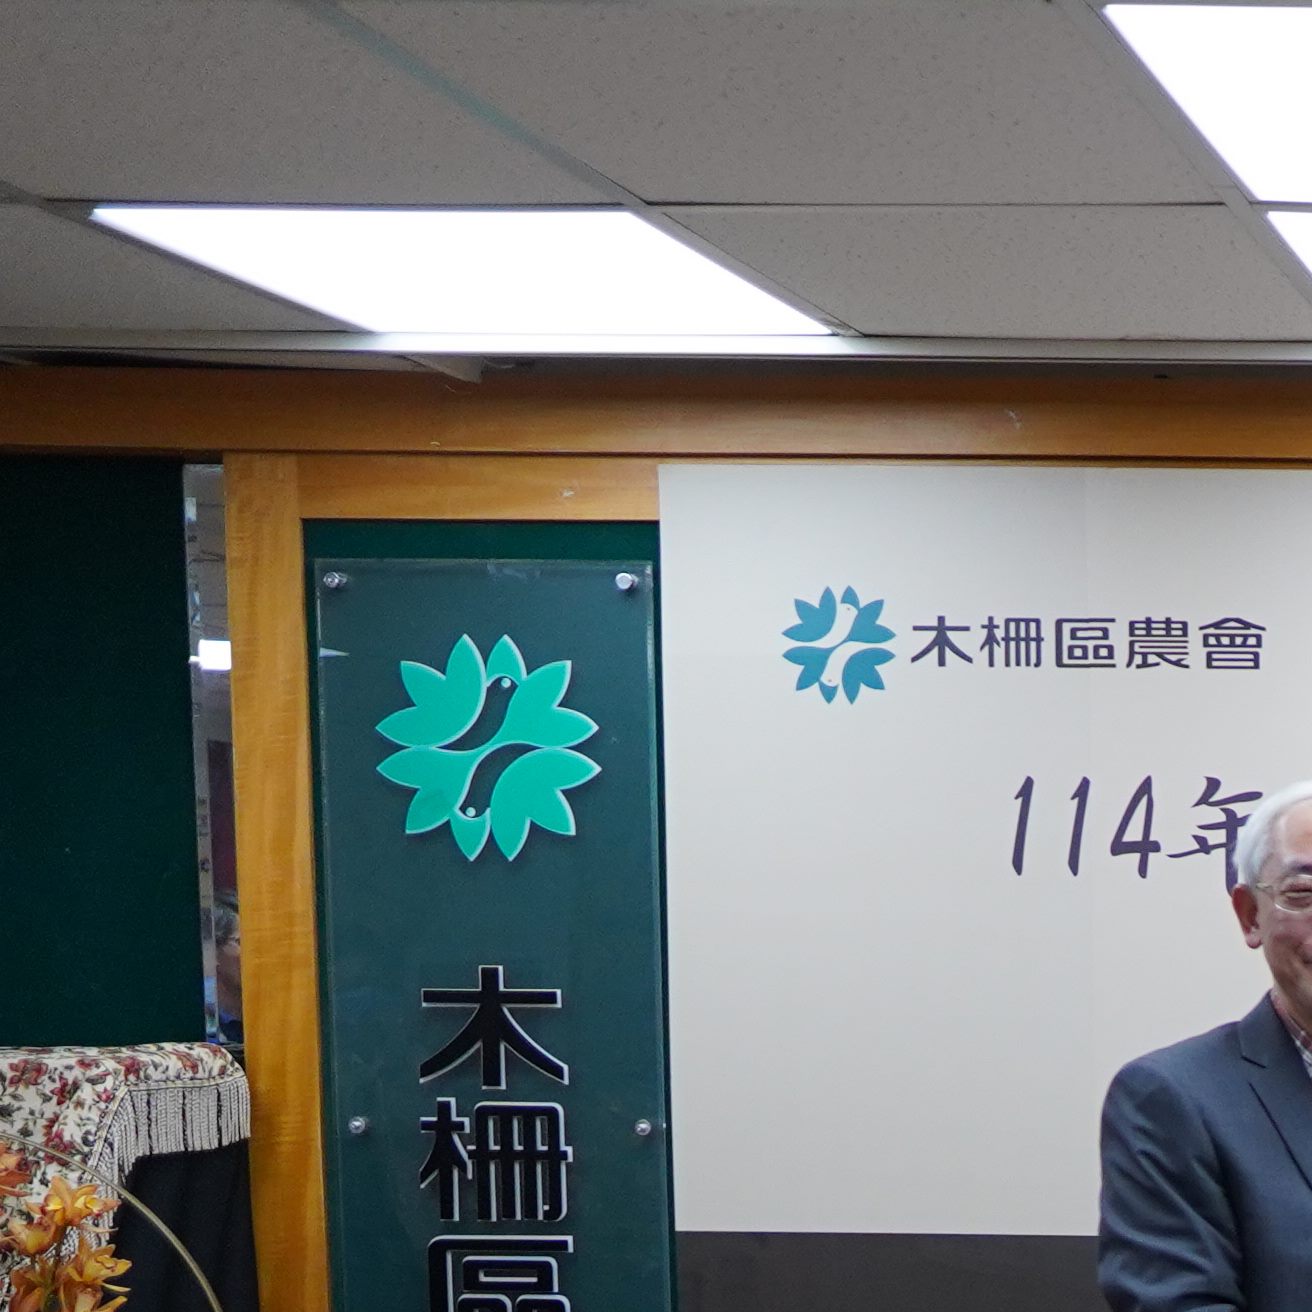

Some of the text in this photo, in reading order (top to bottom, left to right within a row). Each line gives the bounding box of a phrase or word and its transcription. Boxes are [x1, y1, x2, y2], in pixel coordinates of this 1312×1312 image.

[909, 614, 1267, 670] 木柵區農會
